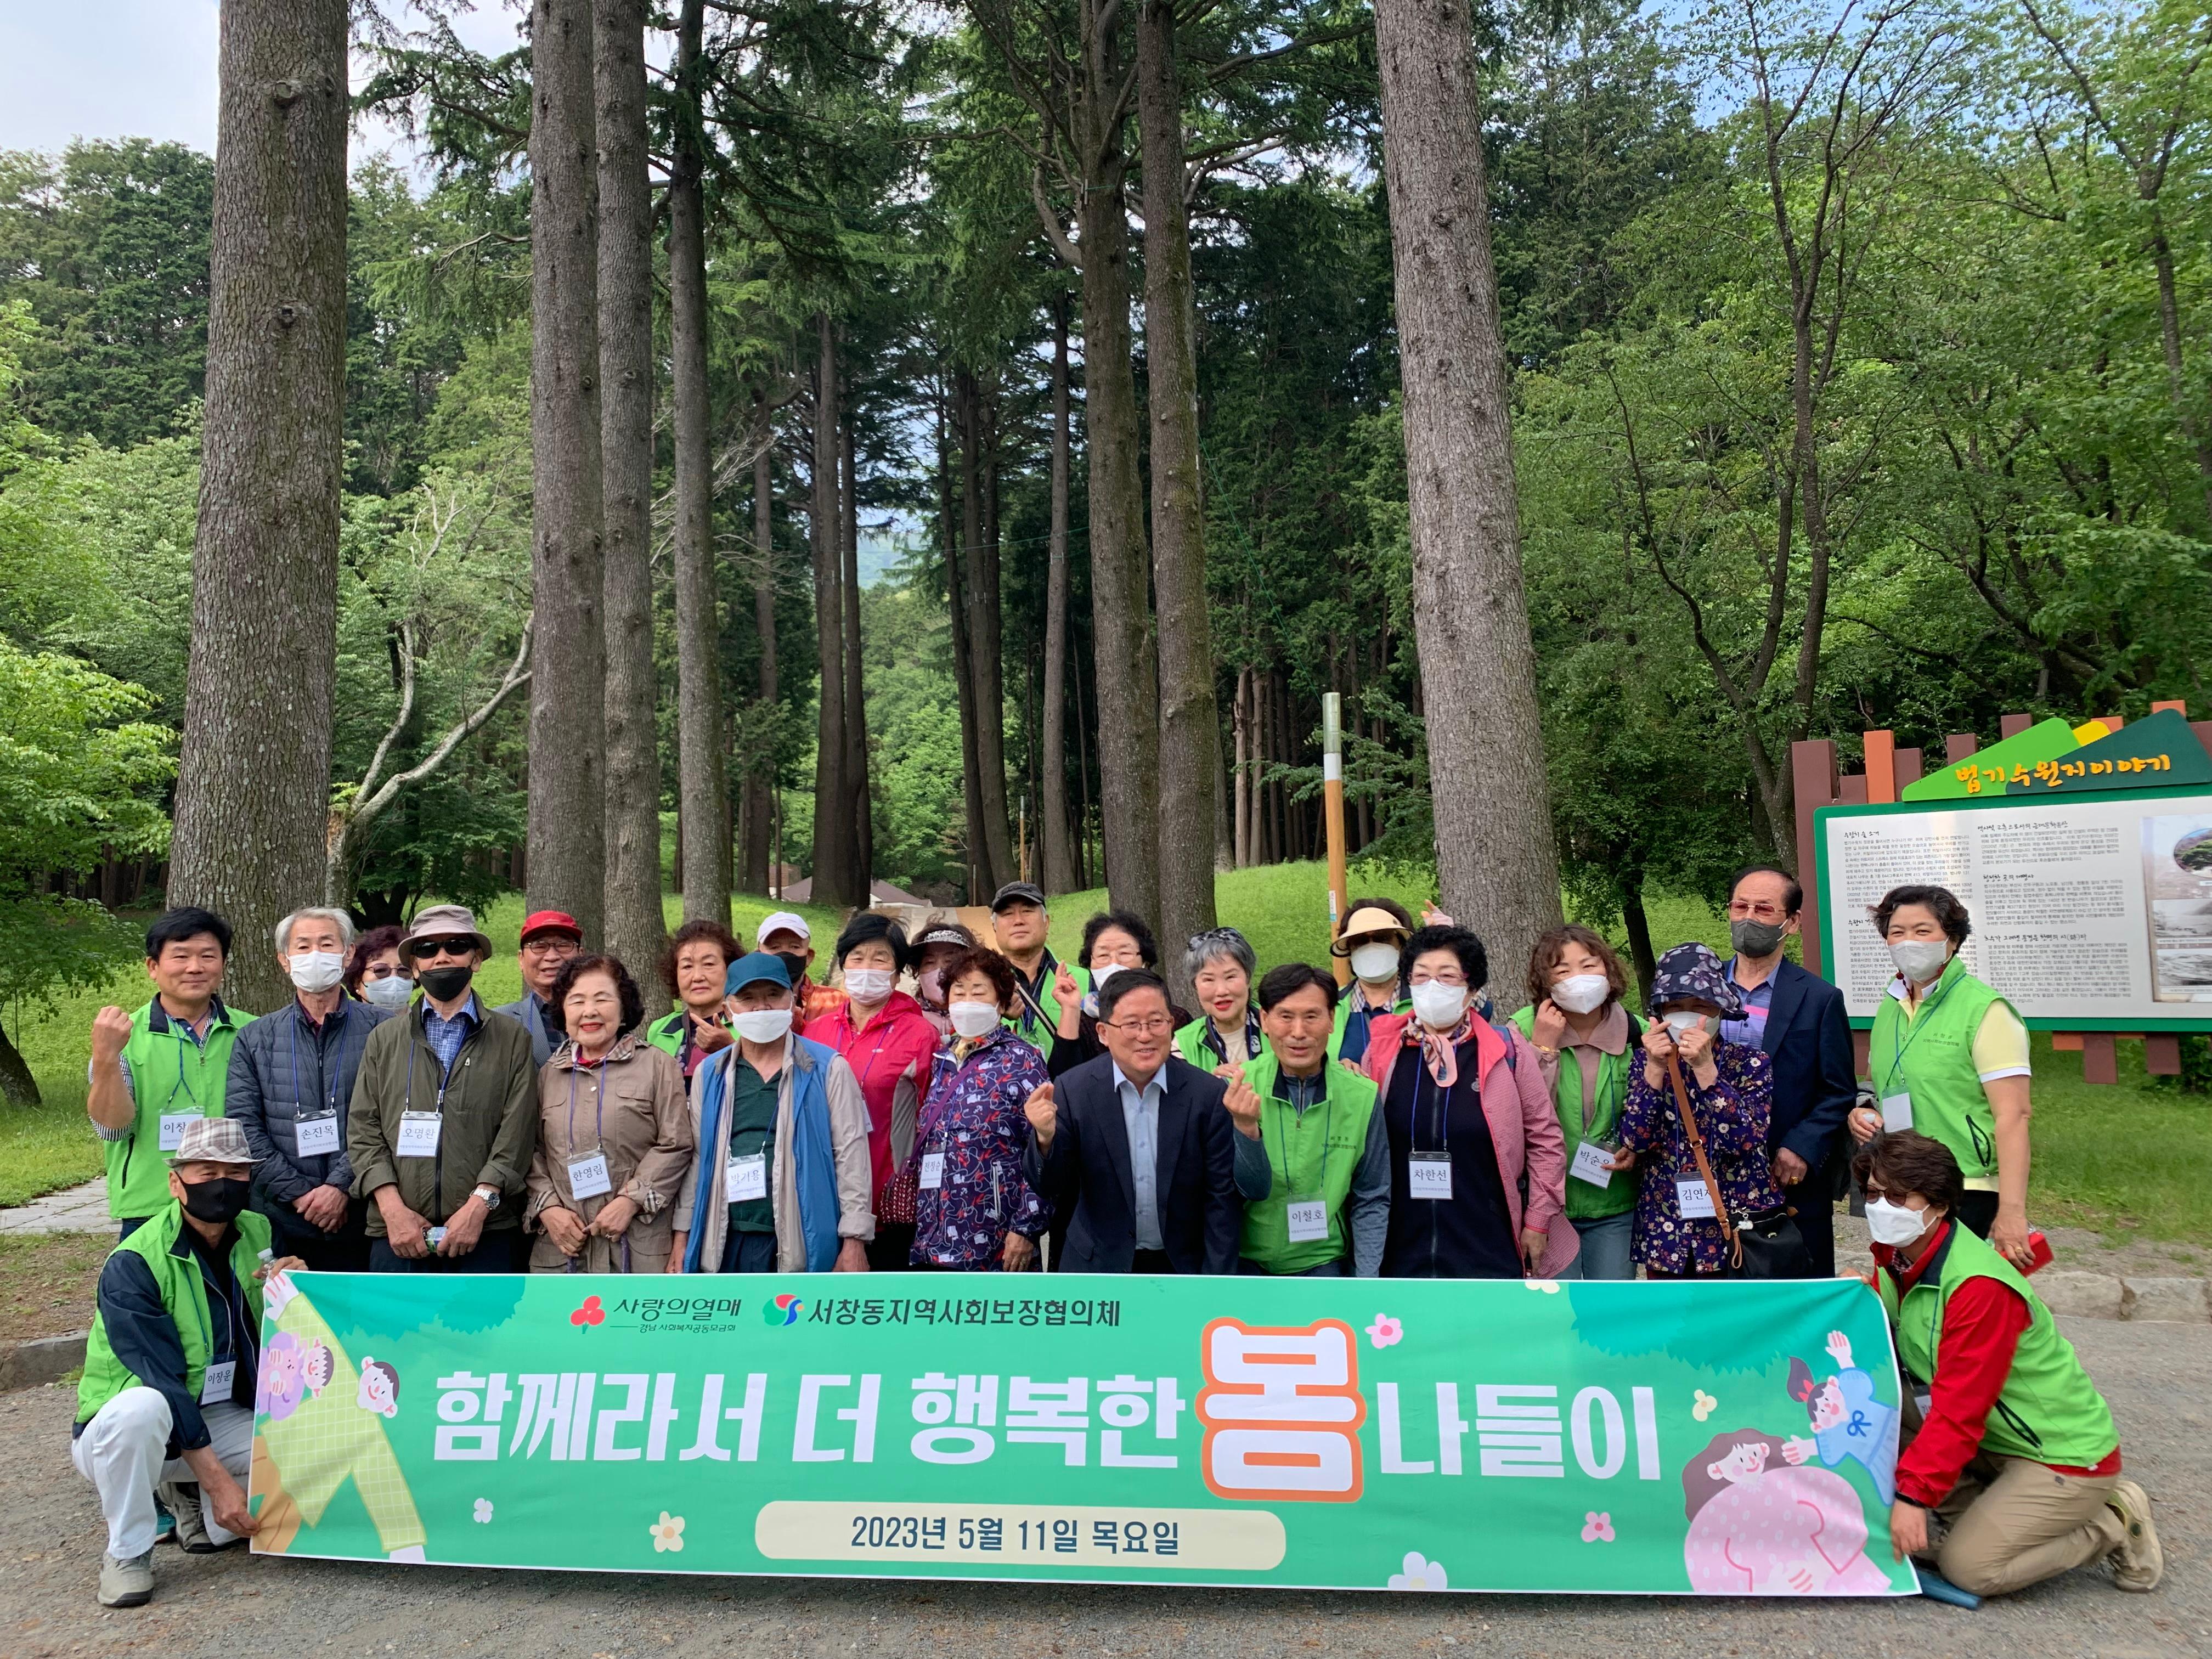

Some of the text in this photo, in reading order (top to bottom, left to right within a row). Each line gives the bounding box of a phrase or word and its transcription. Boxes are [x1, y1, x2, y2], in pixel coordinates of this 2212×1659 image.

[302, 1125, 334, 1140] 손진목
[402, 1128, 435, 1139] 오명환
[573, 1164, 603, 1181] 한영림
[731, 1170, 760, 1184] 박기용
[1413, 1169, 1447, 1181] 차한선
[1291, 1210, 1323, 1223] 이철호
[614, 1299, 741, 1321] 사랑의열매
[808, 1299, 1120, 1327] 서창동지역사회보장협의체
[639, 1324, 736, 1333] 경남 사회복지공동모금회
[208, 1369, 231, 1384] 이장운
[435, 1372, 767, 1461] 함께라서
[793, 1374, 881, 1462] 더
[911, 1373, 1186, 1468] 행복한
[852, 1516, 1179, 1555] 2023년 5월 11일 목요일
